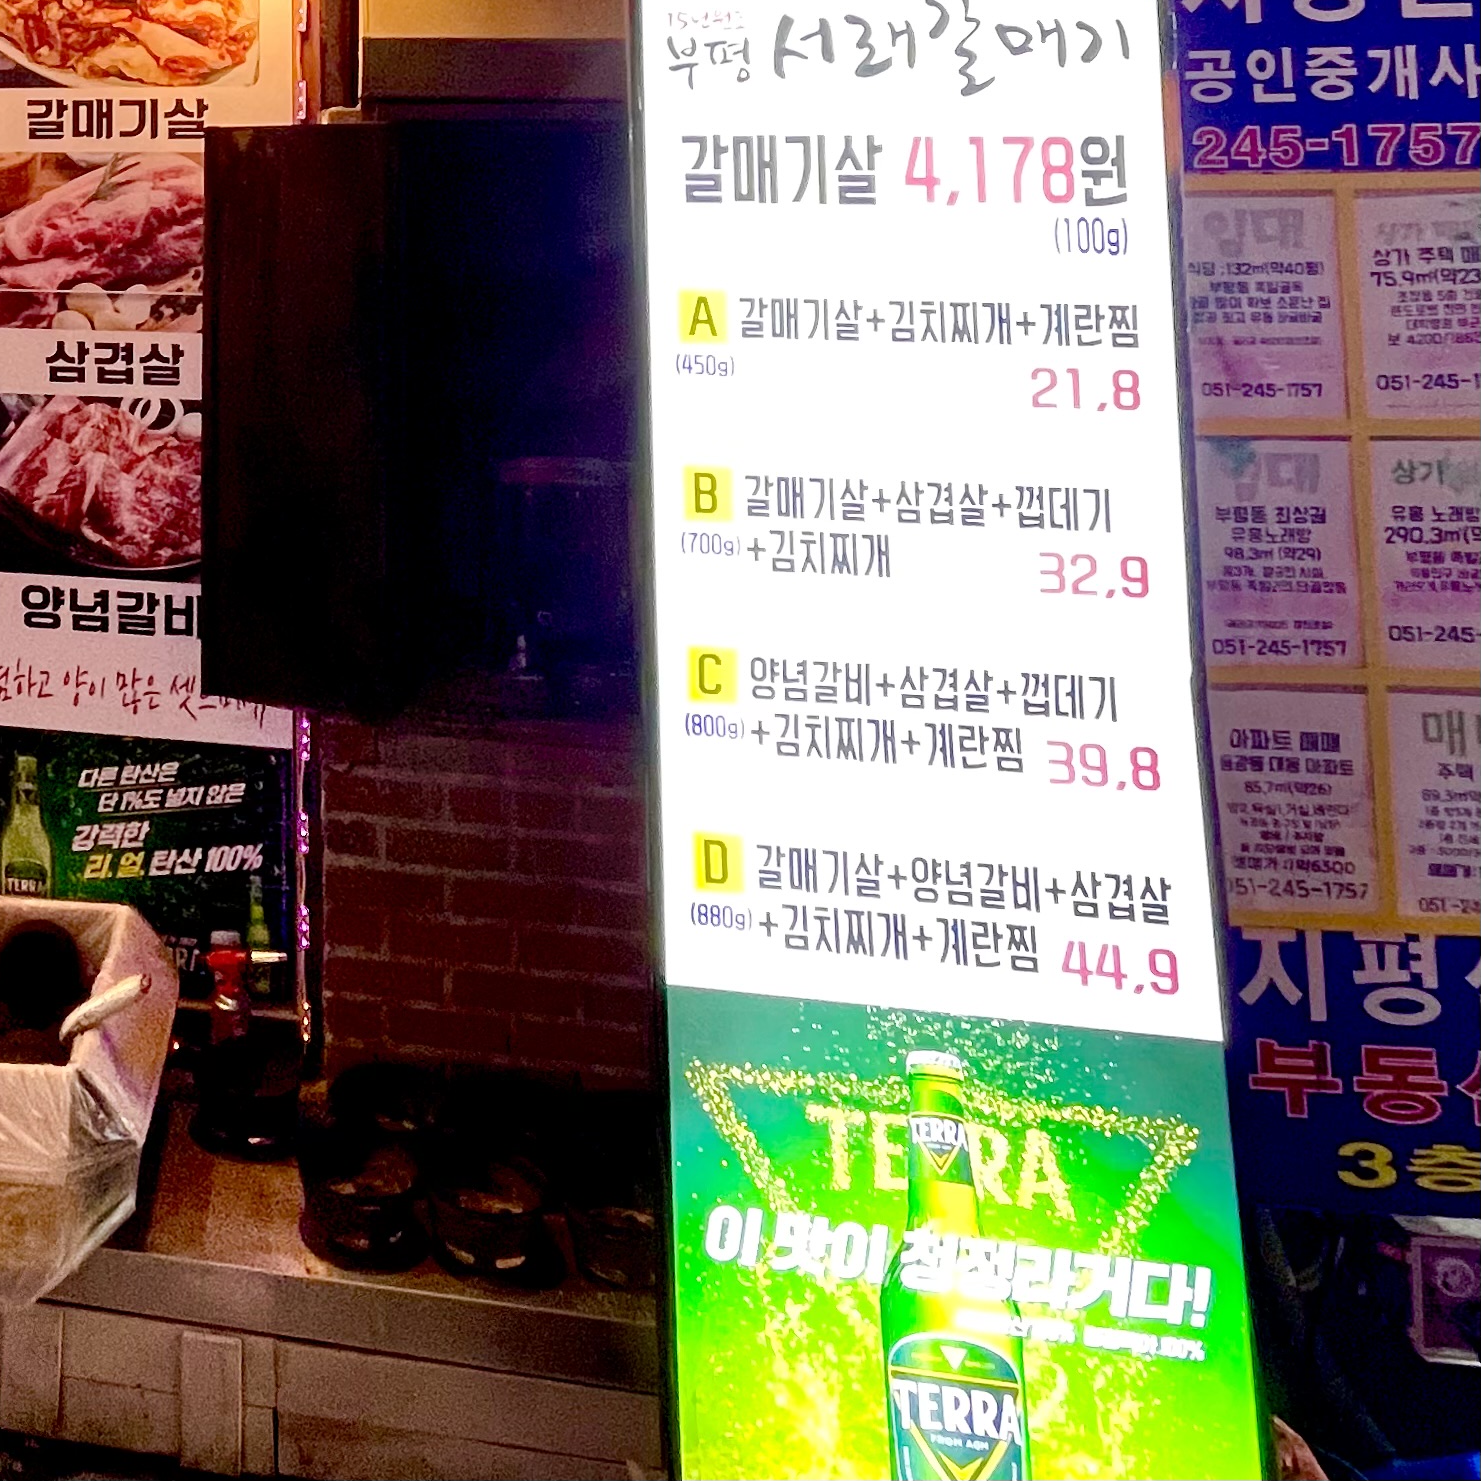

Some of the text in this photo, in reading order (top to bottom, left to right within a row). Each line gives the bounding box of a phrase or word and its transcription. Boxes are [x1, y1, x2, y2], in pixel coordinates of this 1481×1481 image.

[668, 35, 751, 89] 부평
[1184, 43, 1481, 104] 공인중개사
[26, 98, 209, 141] 갈매기살
[1192, 122, 1481, 169] 245-1757
[681, 134, 1128, 206] 갈매기살 4,178원
[1054, 217, 1129, 256] (100g)
[688, 295, 718, 337] A
[45, 340, 185, 387] 삼겹살
[675, 352, 1141, 413] (450g) 21,8
[693, 472, 718, 515] B
[680, 530, 741, 558] (700g)
[1039, 551, 1151, 599] 32,9
[21, 584, 202, 638] 양념갈비
[1212, 638, 1347, 657] 051-245-1757
[63, 665, 107, 707] 양이
[116, 665, 162, 715] 많은
[698, 653, 723, 695] C
[685, 712, 746, 740] (800g)
[1046, 739, 1161, 792] 39,8
[1229, 728, 1293, 752] 아파트
[71, 820, 151, 852] 강력한
[150, 843, 264, 877] 탄산 100%
[704, 839, 728, 884] D
[690, 901, 753, 932] (880g)
[1061, 939, 1180, 996] 44,9
[1238, 927, 1481, 1027] 지평
[910, 1116, 970, 1152] TERRA
[804, 1100, 1077, 1222] TERA
[1337, 1141, 1481, 1193] 3층
[891, 1376, 1023, 1446] TERRA
